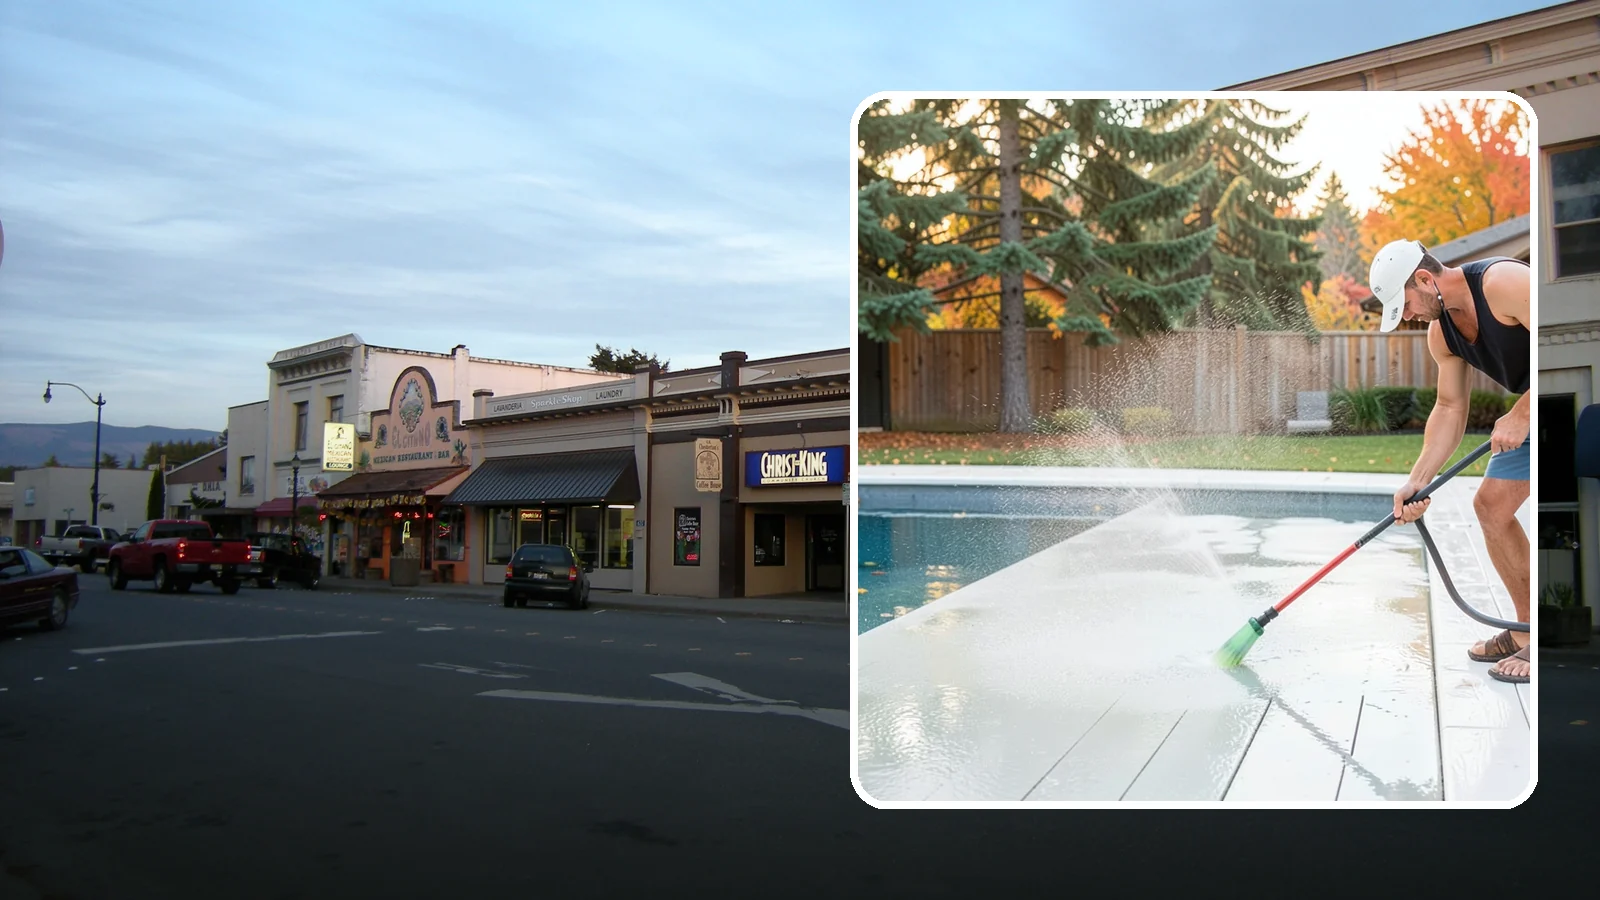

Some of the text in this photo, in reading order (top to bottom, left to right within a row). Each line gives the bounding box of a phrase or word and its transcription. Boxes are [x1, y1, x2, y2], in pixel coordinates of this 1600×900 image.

[595, 389, 623, 400] LAUNDRY
[493, 402, 522, 413] LAVANDERIA
[531, 394, 582, 409] Sparkle Shop
[374, 450, 450, 464] MEXICAN RESTAURANT BAR
[761, 452, 797, 478] CHRIST
[799, 450, 827, 476] KING
[697, 481, 709, 489] Coffee
